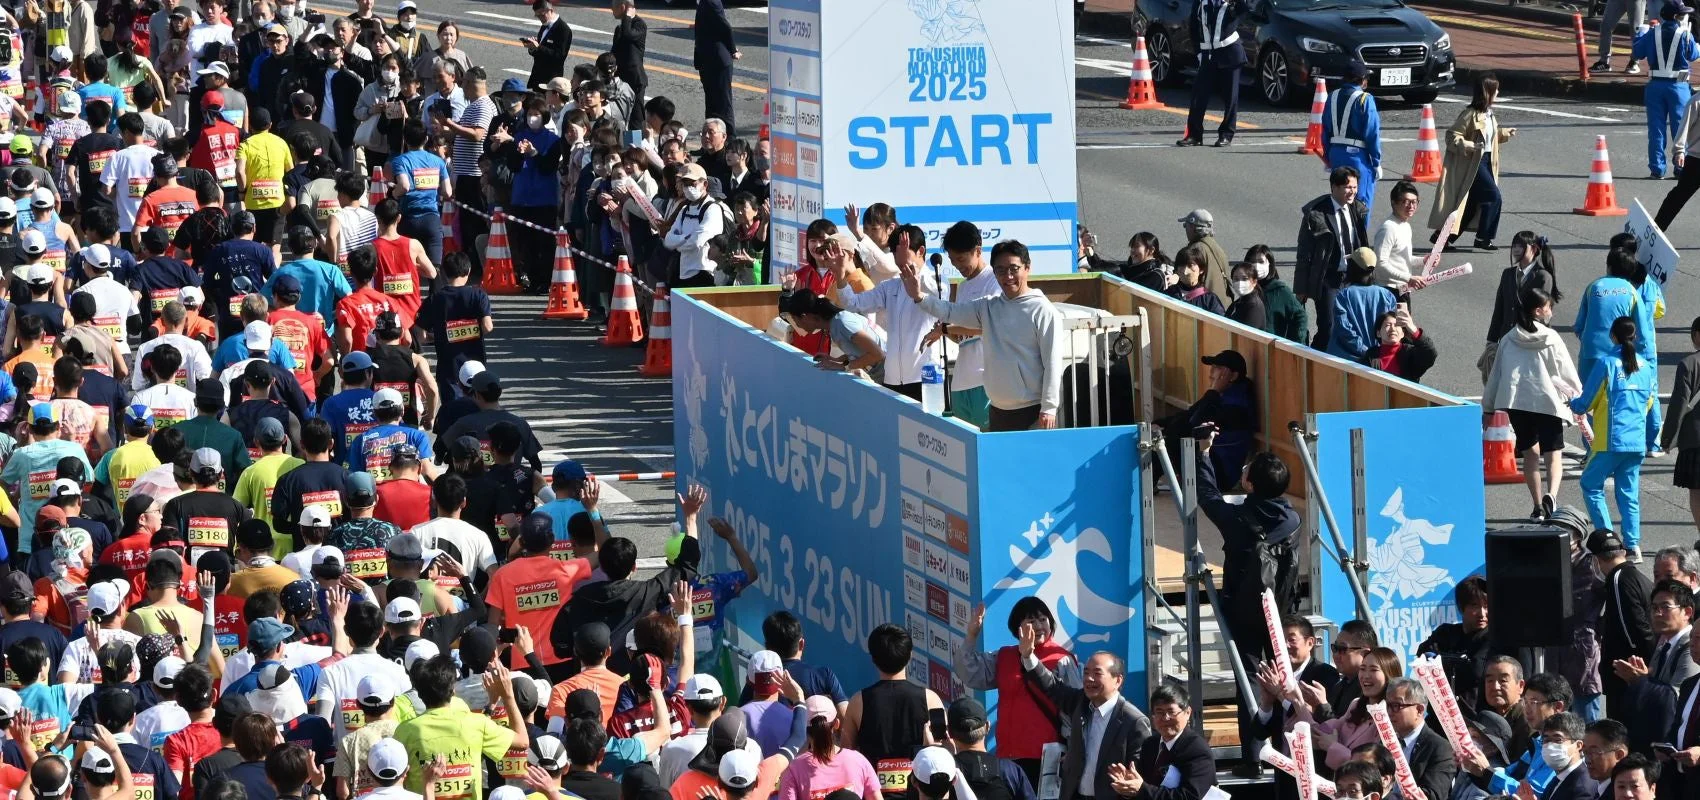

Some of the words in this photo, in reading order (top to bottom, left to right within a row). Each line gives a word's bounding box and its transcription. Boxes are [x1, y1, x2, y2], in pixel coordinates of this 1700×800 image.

[908, 46, 986, 63] TOKUSHIMA
[908, 60, 986, 76] MARATHON
[1387, 75, 1409, 84] 73-13
[908, 73, 987, 102] 2025
[848, 112, 1052, 170] START
[1644, 225, 1656, 248] SS
[1646, 254, 1661, 280] 入口
[447, 326, 480, 339] B3819
[742, 391, 887, 528] とくしまマラソン
[30, 483, 50, 495] B44
[189, 528, 228, 541] B3180
[345, 561, 386, 574] B3437
[515, 580, 556, 593] シティ・ハウジング
[517, 592, 559, 608] B4178
[692, 603, 713, 616] 157
[342, 700, 357, 709] シティ
[434, 779, 471, 792] 3515
[879, 773, 906, 785] B43
